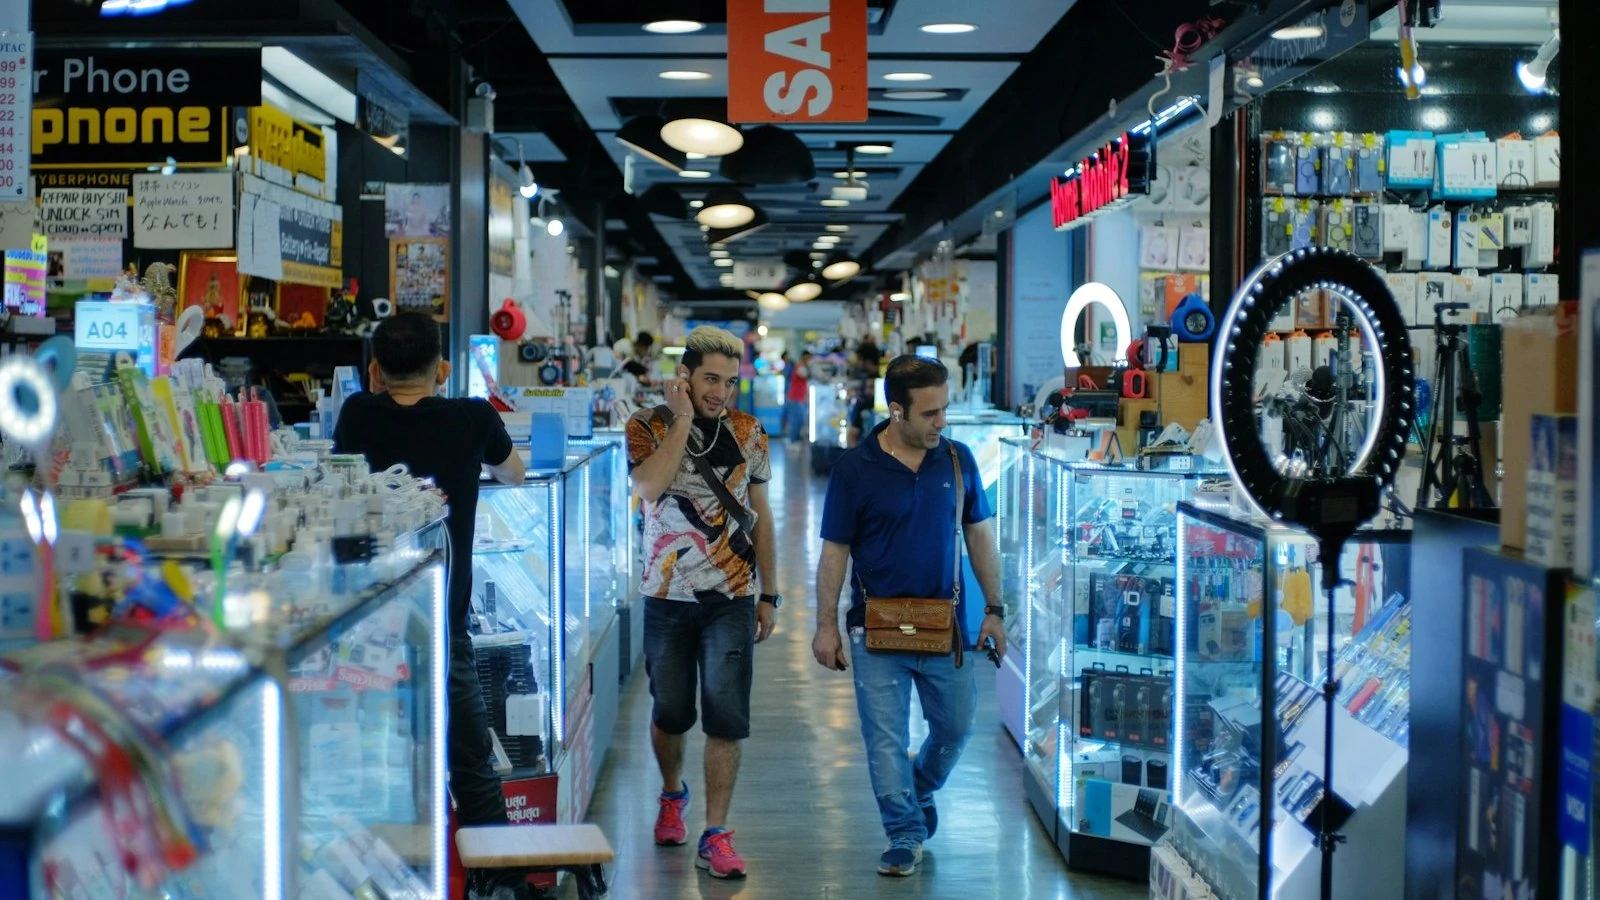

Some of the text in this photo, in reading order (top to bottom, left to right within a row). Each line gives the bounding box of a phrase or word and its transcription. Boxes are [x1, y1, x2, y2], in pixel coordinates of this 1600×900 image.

[764, 0, 833, 117] SA
[64, 56, 190, 93] Phone
[42, 192, 79, 204] REPAIR
[82, 192, 105, 205] BUY
[41, 207, 90, 221] UNLOCK
[87, 321, 128, 339] A04
